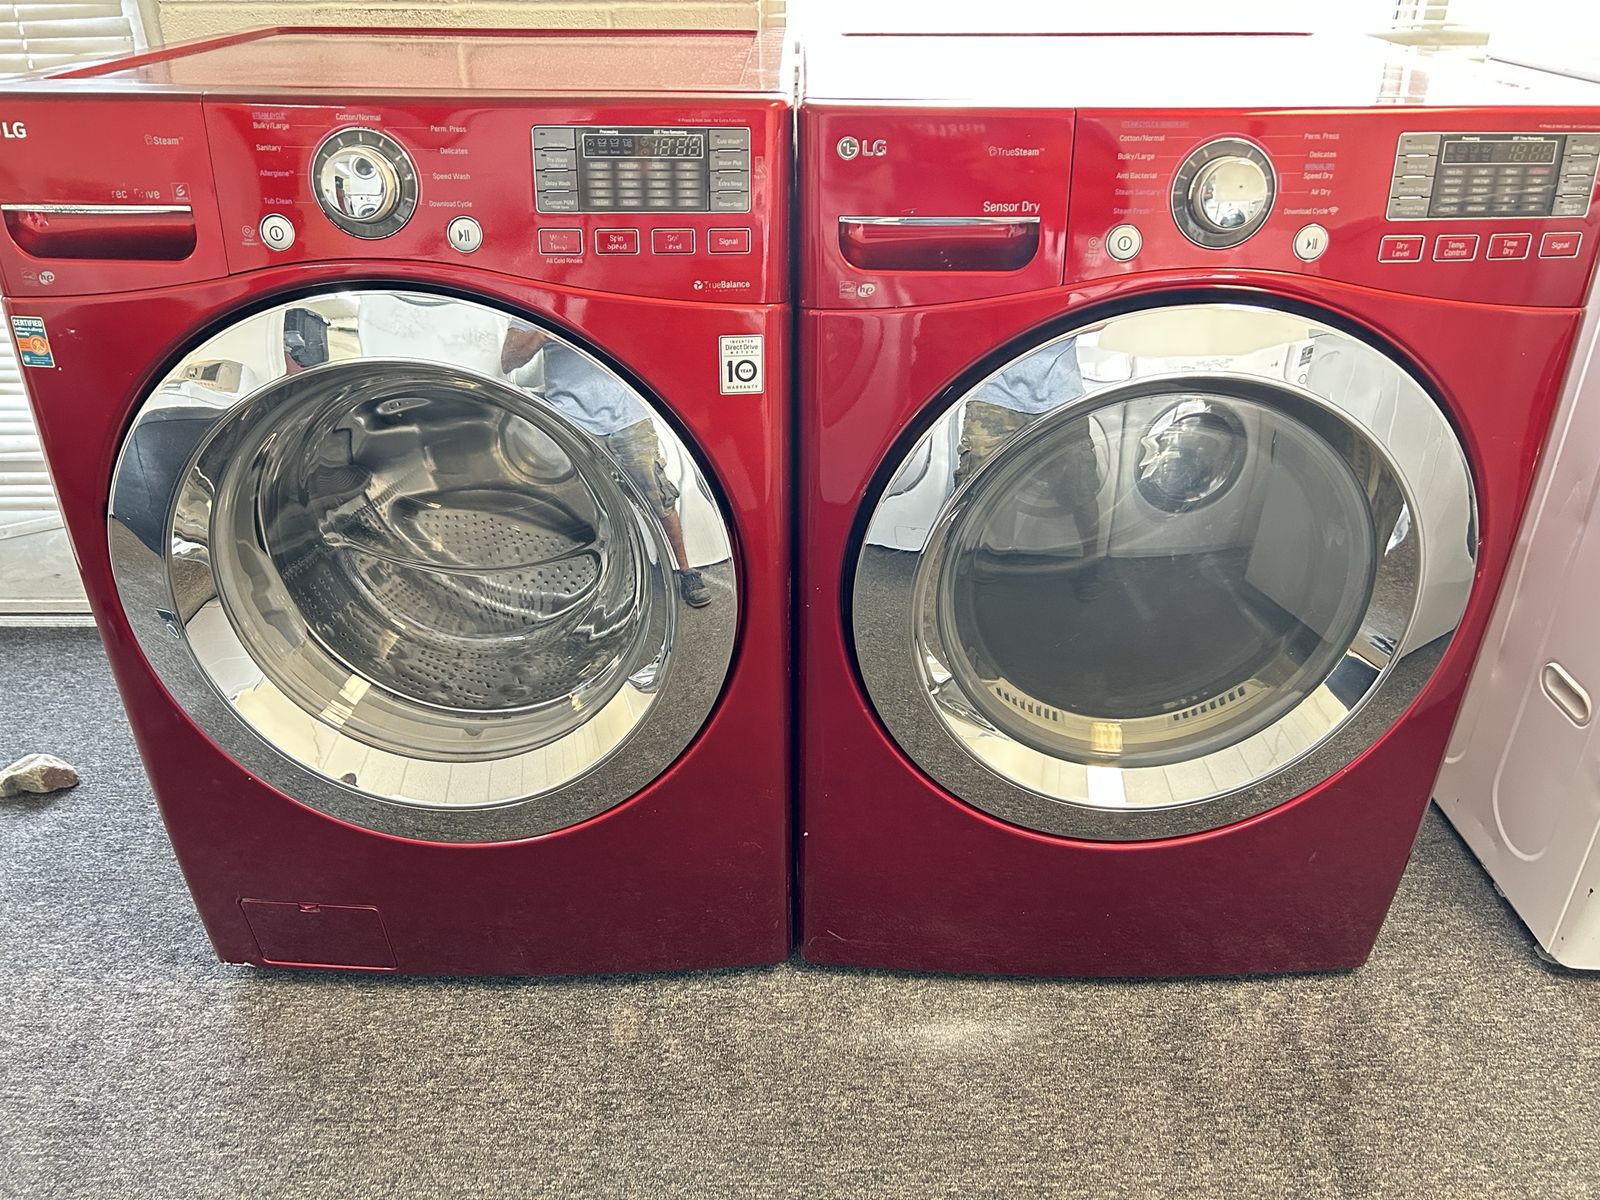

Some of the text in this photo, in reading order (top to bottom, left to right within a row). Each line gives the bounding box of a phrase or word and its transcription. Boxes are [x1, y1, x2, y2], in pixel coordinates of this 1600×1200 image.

[336, 112, 381, 121] Cotton/Normal
[4, 122, 27, 138] LG
[253, 122, 290, 130] Bulky/Large
[256, 144, 282, 152] Sanitary
[862, 139, 887, 156] LG
[432, 173, 450, 181] Speed
[1321, 172, 1334, 180] Dry
[1320, 188, 1332, 196] Dry
[983, 201, 1040, 214] Sensor Dry
[1312, 207, 1328, 215] Cycle
[719, 238, 739, 246] Signal
[1396, 242, 1408, 250] Dry
[1551, 240, 1570, 250] Signal
[1392, 249, 1409, 257] Level
[1444, 249, 1467, 257] Control
[1503, 247, 1514, 256] Dry
[727, 360, 757, 382] 10
